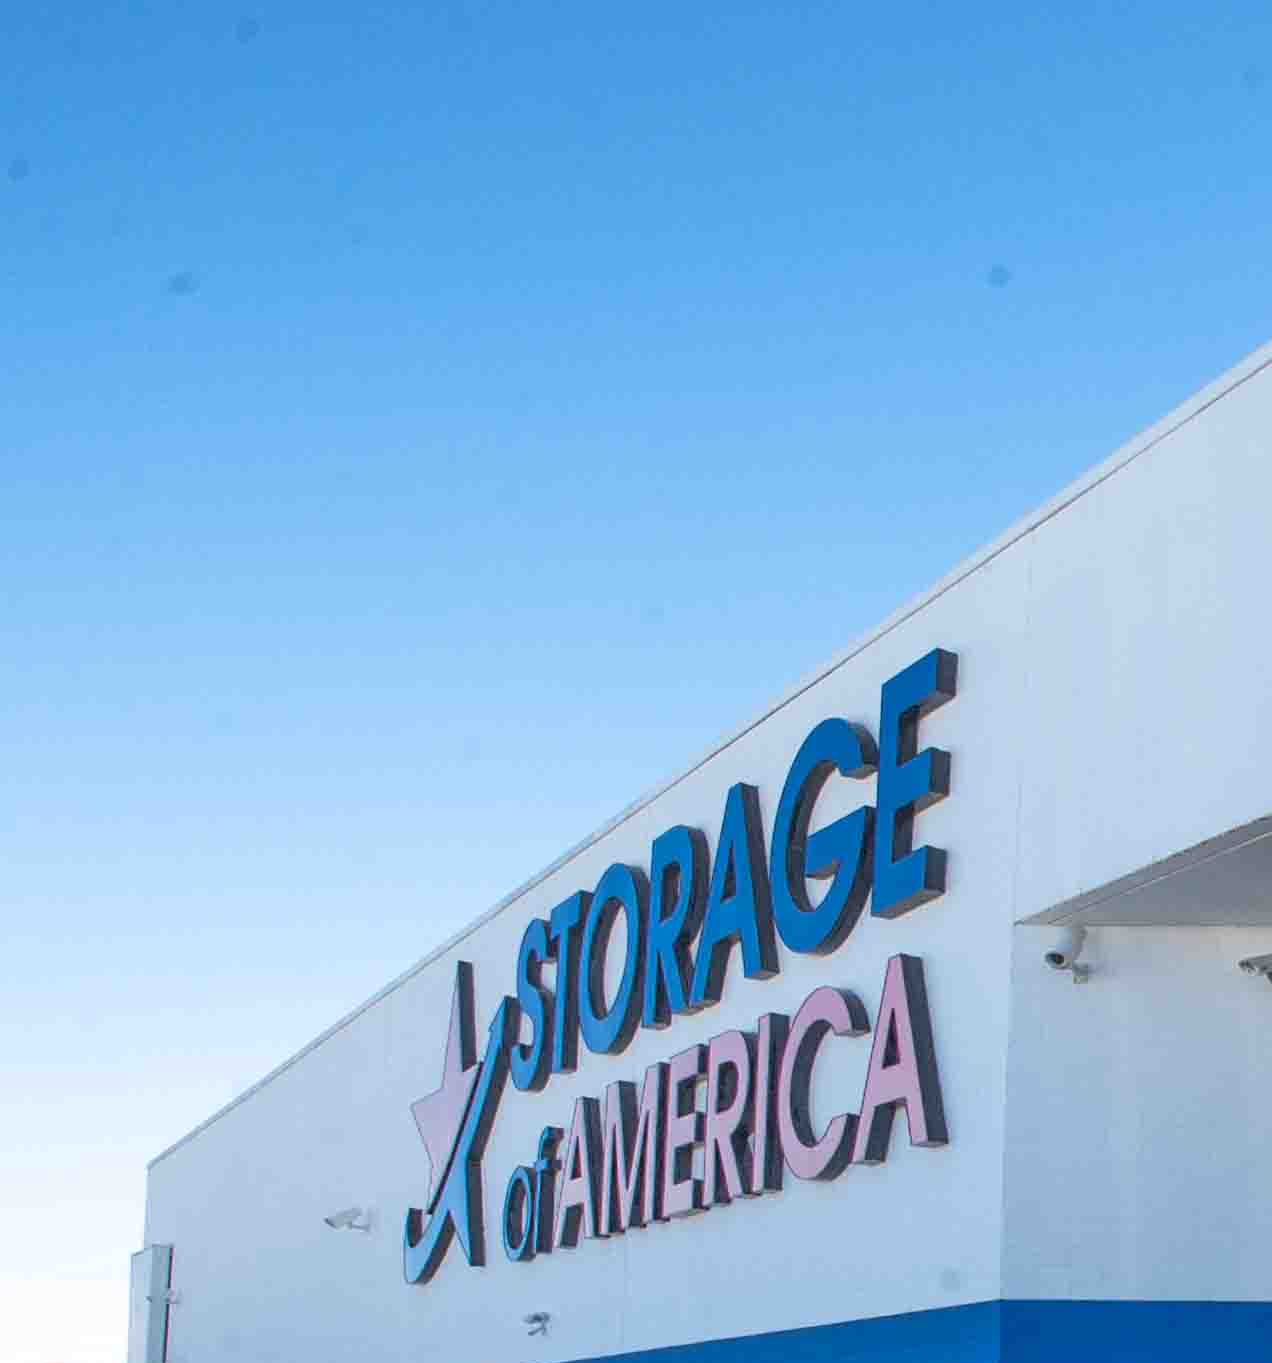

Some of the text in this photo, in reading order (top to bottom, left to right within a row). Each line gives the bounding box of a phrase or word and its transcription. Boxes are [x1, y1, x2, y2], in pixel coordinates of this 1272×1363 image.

[511, 648, 958, 1092] STORAGE
[503, 954, 949, 1261] of AMERICA
